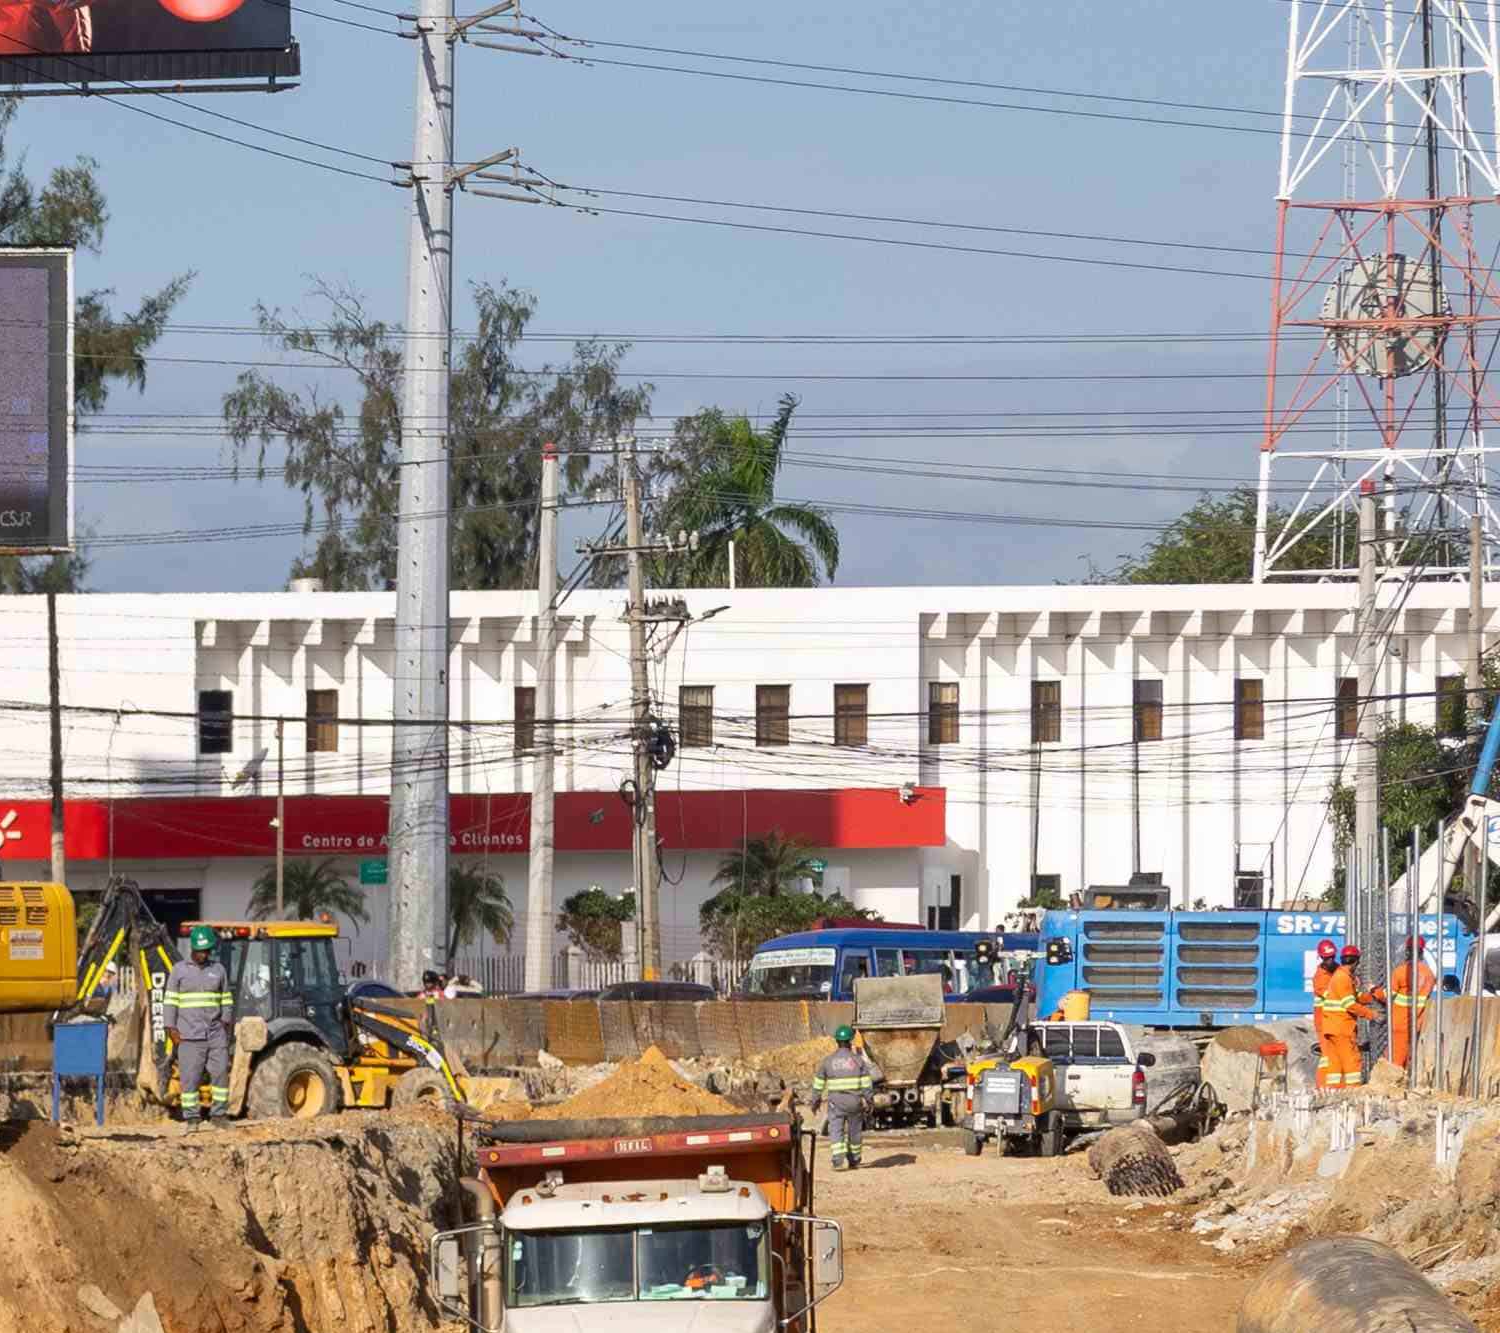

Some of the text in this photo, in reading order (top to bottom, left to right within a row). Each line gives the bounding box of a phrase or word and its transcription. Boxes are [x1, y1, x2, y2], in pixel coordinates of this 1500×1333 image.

[302, 834, 352, 848] Centro
[357, 834, 375, 848] de
[462, 833, 524, 846] Clientes
[150, 971, 167, 1043] DEERE
